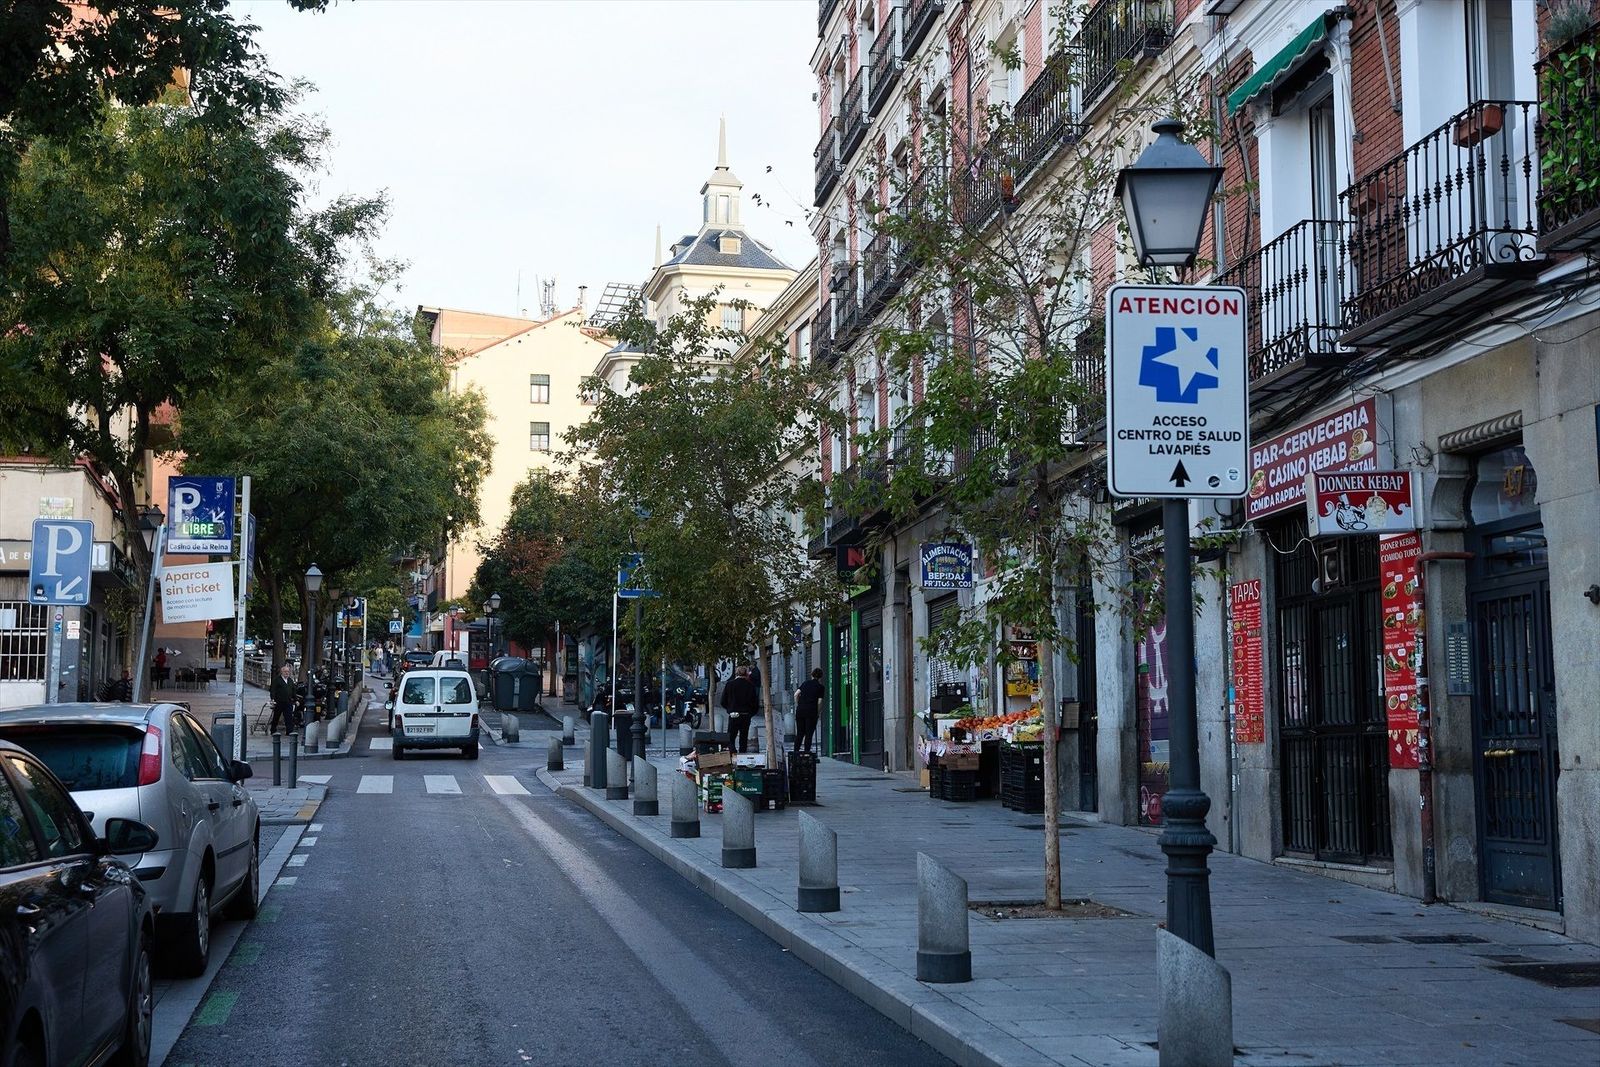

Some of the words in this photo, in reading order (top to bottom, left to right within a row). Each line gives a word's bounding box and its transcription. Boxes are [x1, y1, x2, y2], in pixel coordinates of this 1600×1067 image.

[1118, 295, 1238, 316] ATENCIÓN
[1152, 415, 1207, 427] ACCESO
[1117, 429, 1172, 440] CENTRO
[1176, 430, 1193, 441] DE
[1198, 431, 1242, 442] SALUD
[1253, 406, 1369, 469] BAR-CERVECERIA
[1148, 442, 1211, 455] LAVAPIÉS
[1268, 457, 1307, 488] CASINO
[1308, 441, 1347, 472] KEBAB
[1318, 476, 1364, 493] DONNER
[1368, 475, 1404, 491] KEBAP
[174, 487, 201, 523] P
[1250, 492, 1275, 514] COMIDA
[184, 515, 200, 523] 24h
[182, 523, 214, 535] LIBRE
[40, 525, 82, 576] P
[169, 543, 191, 551] Casino
[192, 543, 201, 551] de
[210, 543, 228, 551] Reina
[922, 545, 971, 567] ALIMENTACIÓN
[165, 570, 209, 584] Aparca
[166, 585, 183, 596] sin
[186, 582, 221, 595] ticket
[1232, 580, 1260, 604] TAPAS
